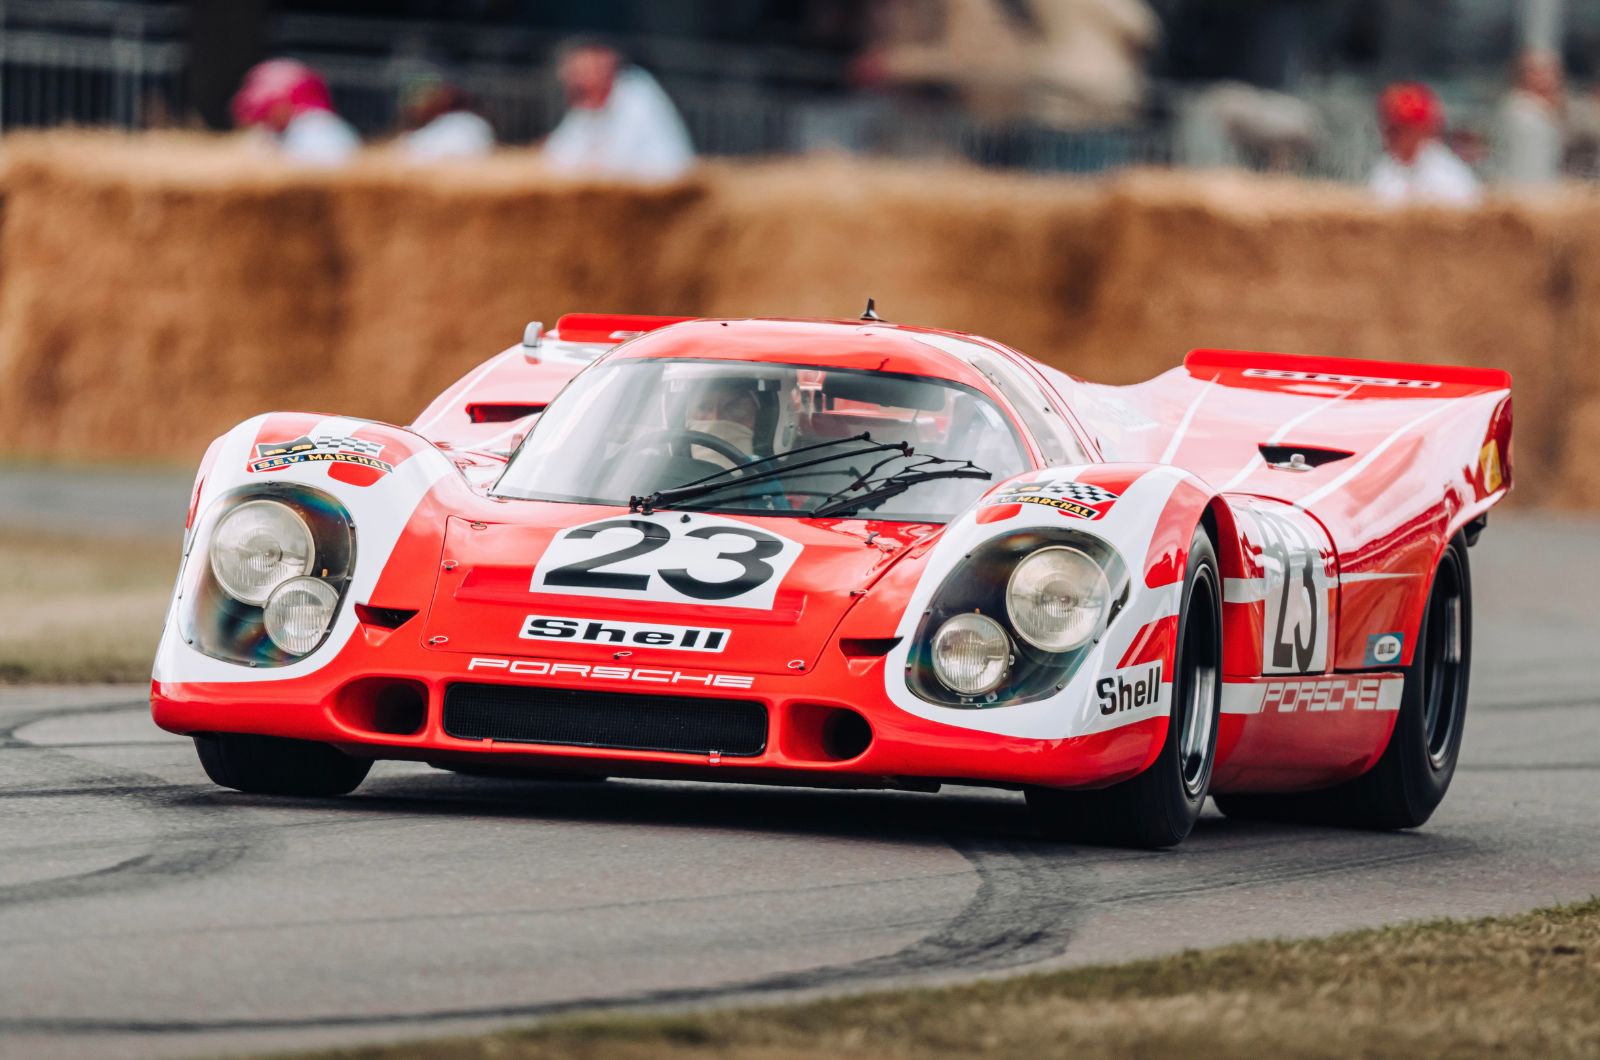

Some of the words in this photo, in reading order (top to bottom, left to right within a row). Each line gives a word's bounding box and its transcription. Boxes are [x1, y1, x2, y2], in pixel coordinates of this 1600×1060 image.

[257, 455, 304, 470] S.E.V.
[308, 453, 386, 470] MARCHAL
[1017, 495, 1088, 517] MARCHAL
[543, 519, 784, 601] 23
[1248, 510, 1318, 673] 23
[527, 618, 724, 650] Shell
[468, 657, 755, 689] PORSCHE
[1096, 665, 1161, 716] Shell
[1260, 679, 1380, 713] PORSCHE
